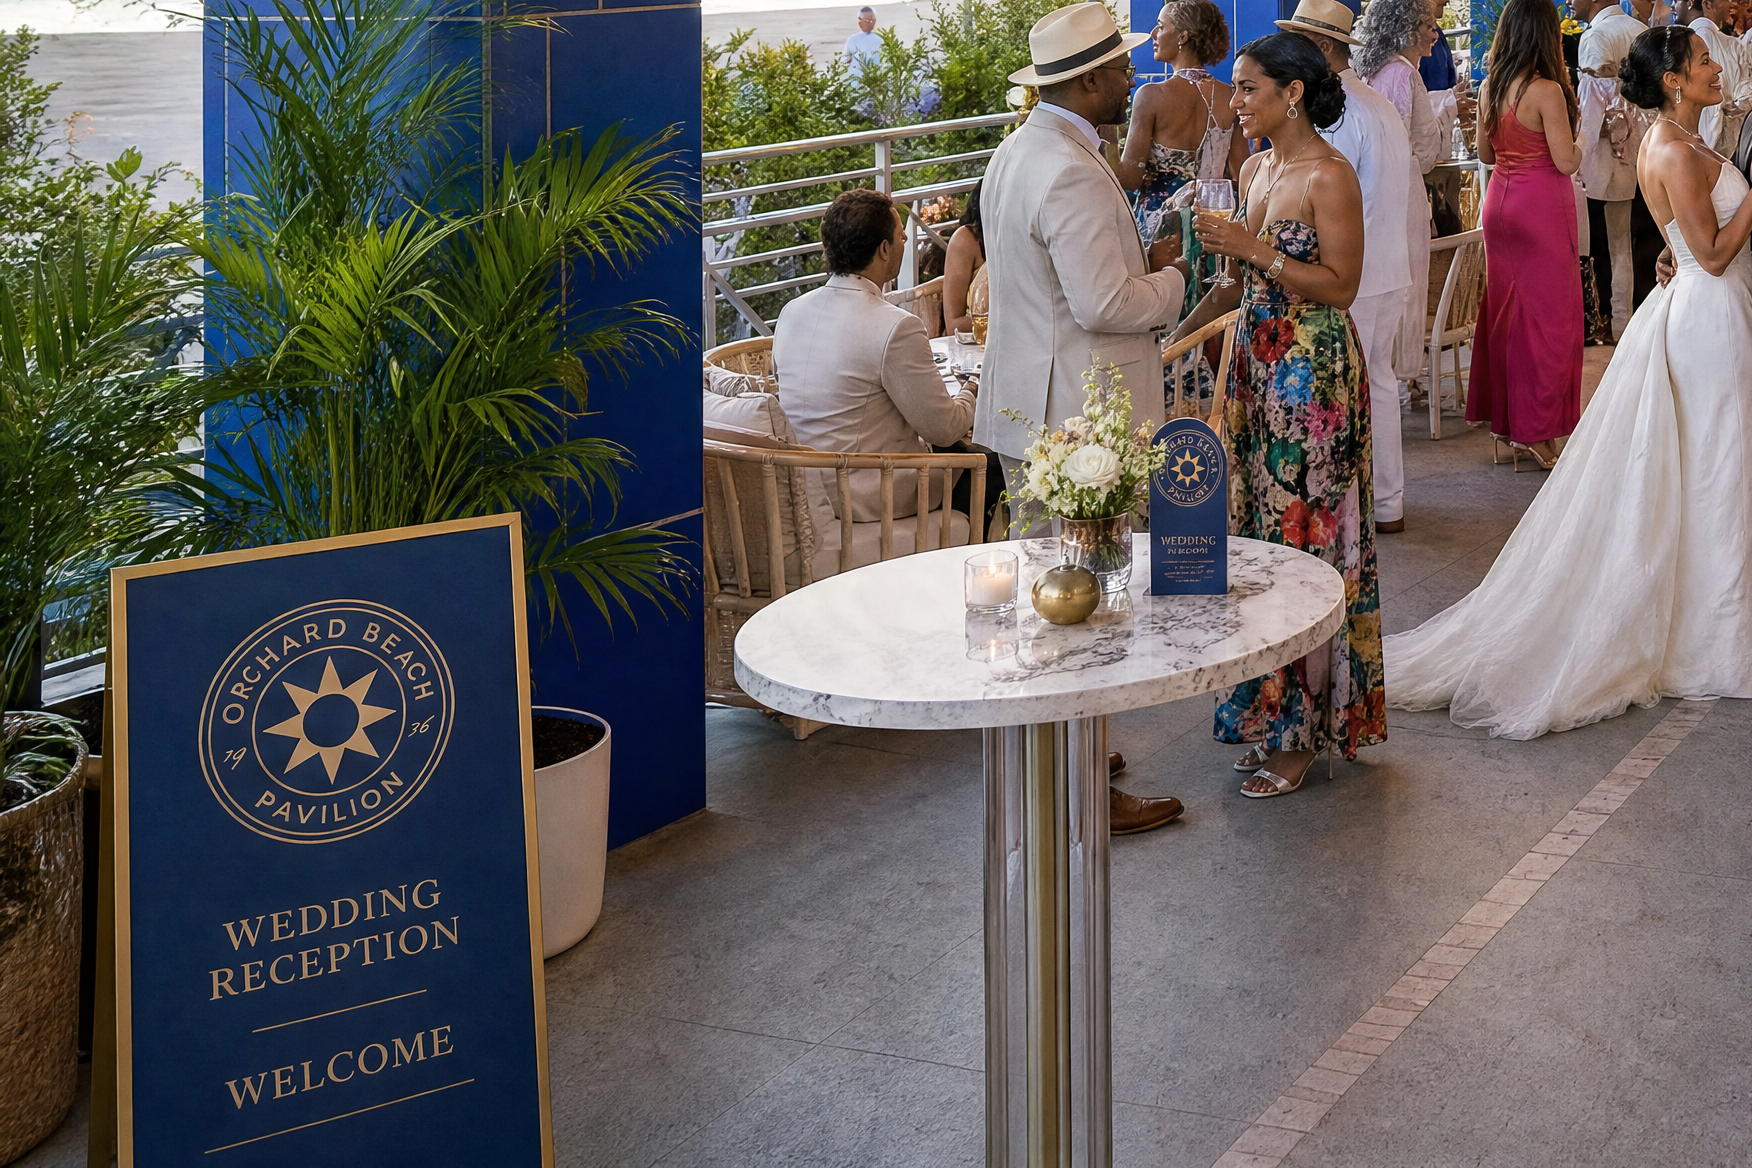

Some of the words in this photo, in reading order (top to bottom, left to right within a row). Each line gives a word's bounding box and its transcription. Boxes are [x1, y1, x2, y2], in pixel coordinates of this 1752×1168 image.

[1160, 535, 1217, 546] WEDDING
[222, 619, 347, 725] ORCHARD
[362, 622, 434, 701] BEACH
[408, 714, 435, 738] 36
[223, 747, 247, 771] 19
[255, 771, 404, 824] PAVILION
[222, 879, 442, 951] WEDDING
[208, 915, 460, 1001] RECEPTION
[224, 1025, 454, 1110] WELCOME
